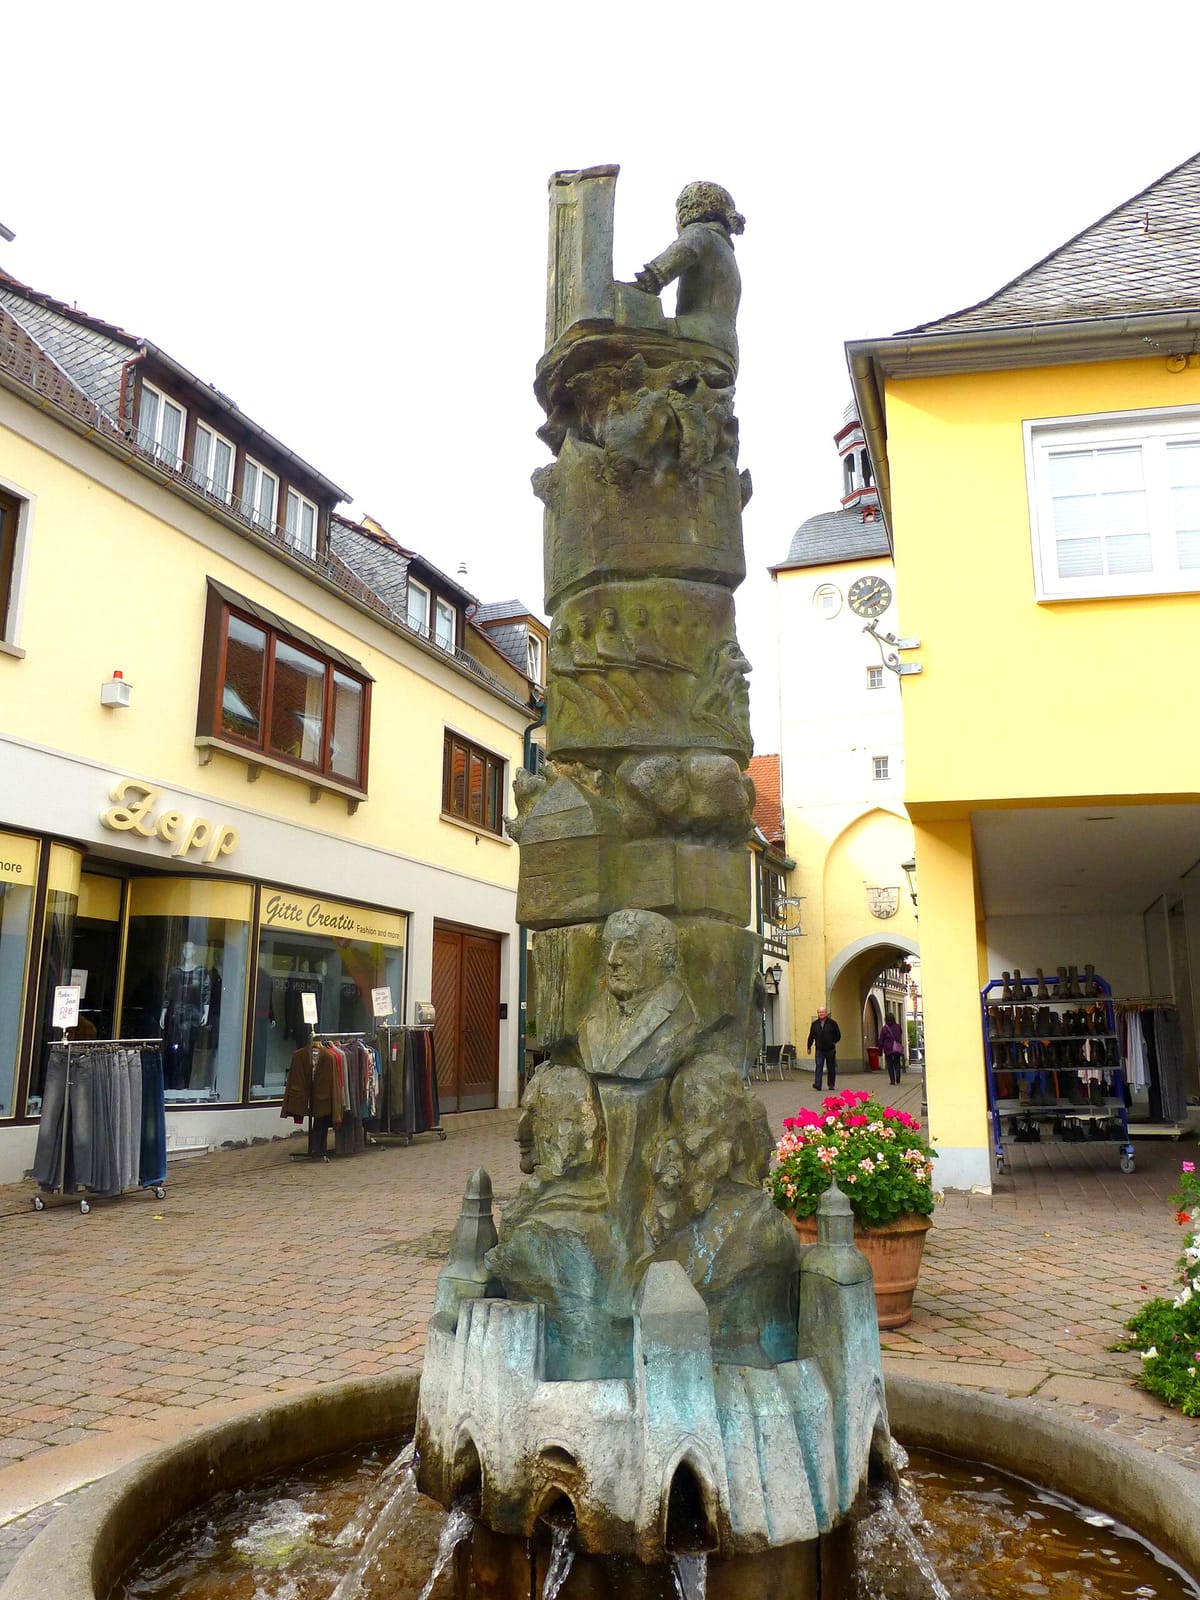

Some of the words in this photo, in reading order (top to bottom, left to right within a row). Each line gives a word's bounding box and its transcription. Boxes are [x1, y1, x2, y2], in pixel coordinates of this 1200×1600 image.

[98, 779, 239, 864] Zepp
[266, 895, 303, 925] Gitte
[306, 903, 355, 931] Creativ
[356, 924, 377, 936] Fashion
[377, 928, 388, 938] and
[388, 930, 400, 940] more
